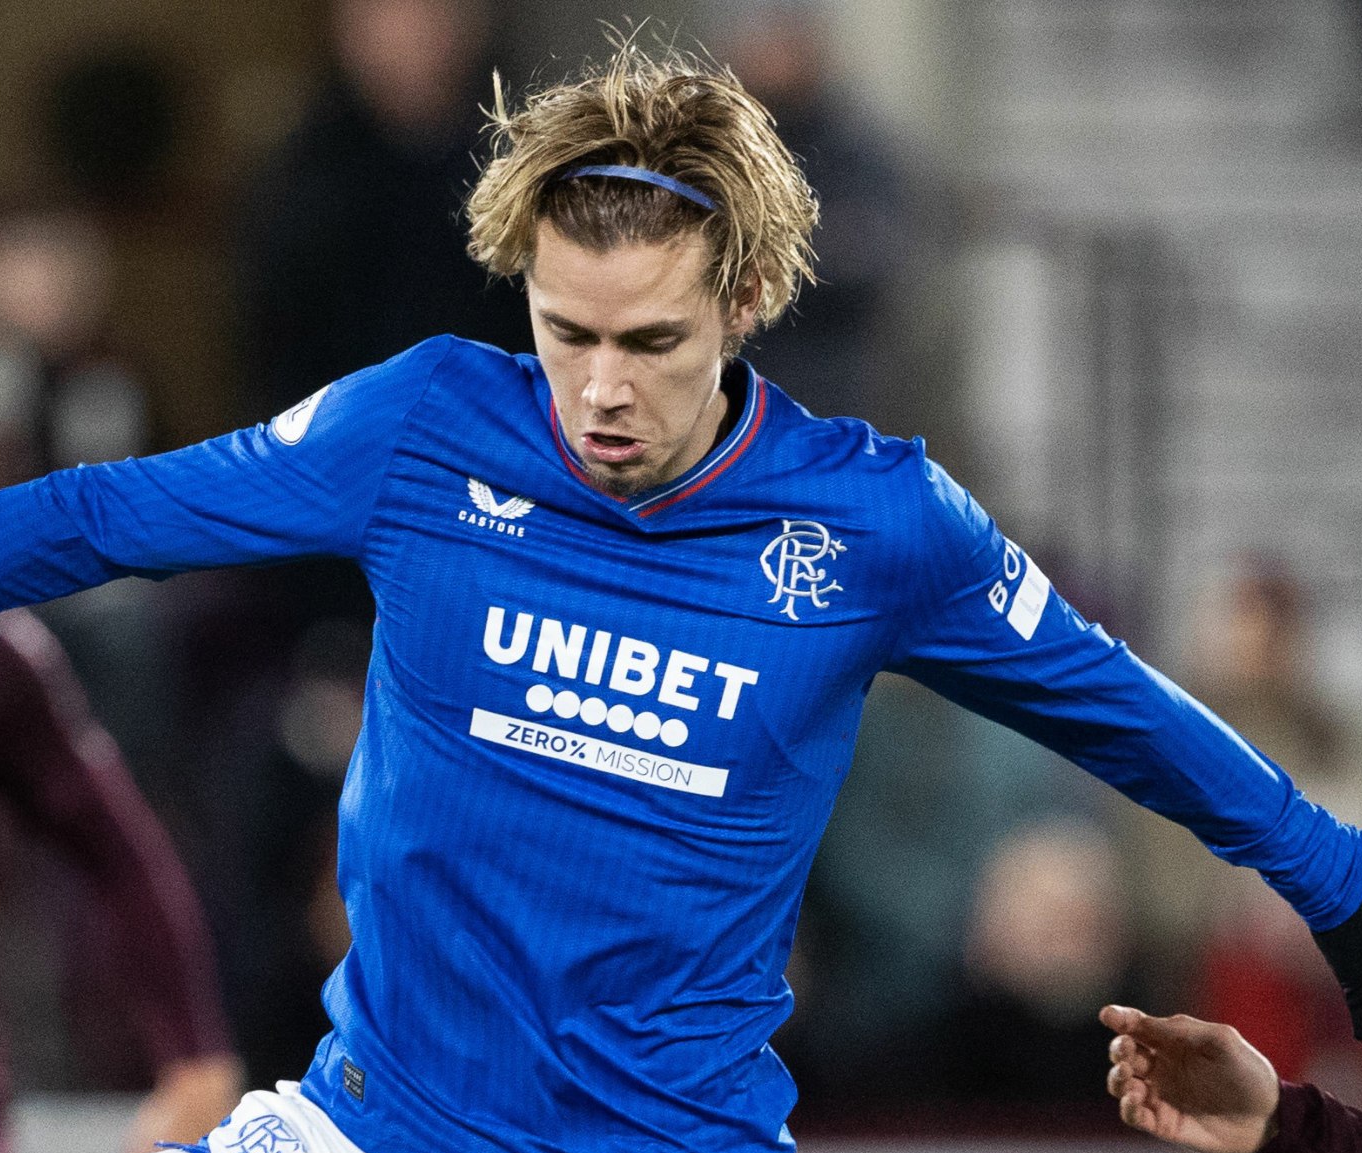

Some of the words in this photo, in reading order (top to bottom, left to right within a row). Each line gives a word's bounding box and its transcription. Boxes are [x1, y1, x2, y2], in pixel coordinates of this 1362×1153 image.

[458, 509, 525, 538] CASTORE
[482, 606, 759, 720] UNIBET
[595, 745, 693, 787] MISSION
